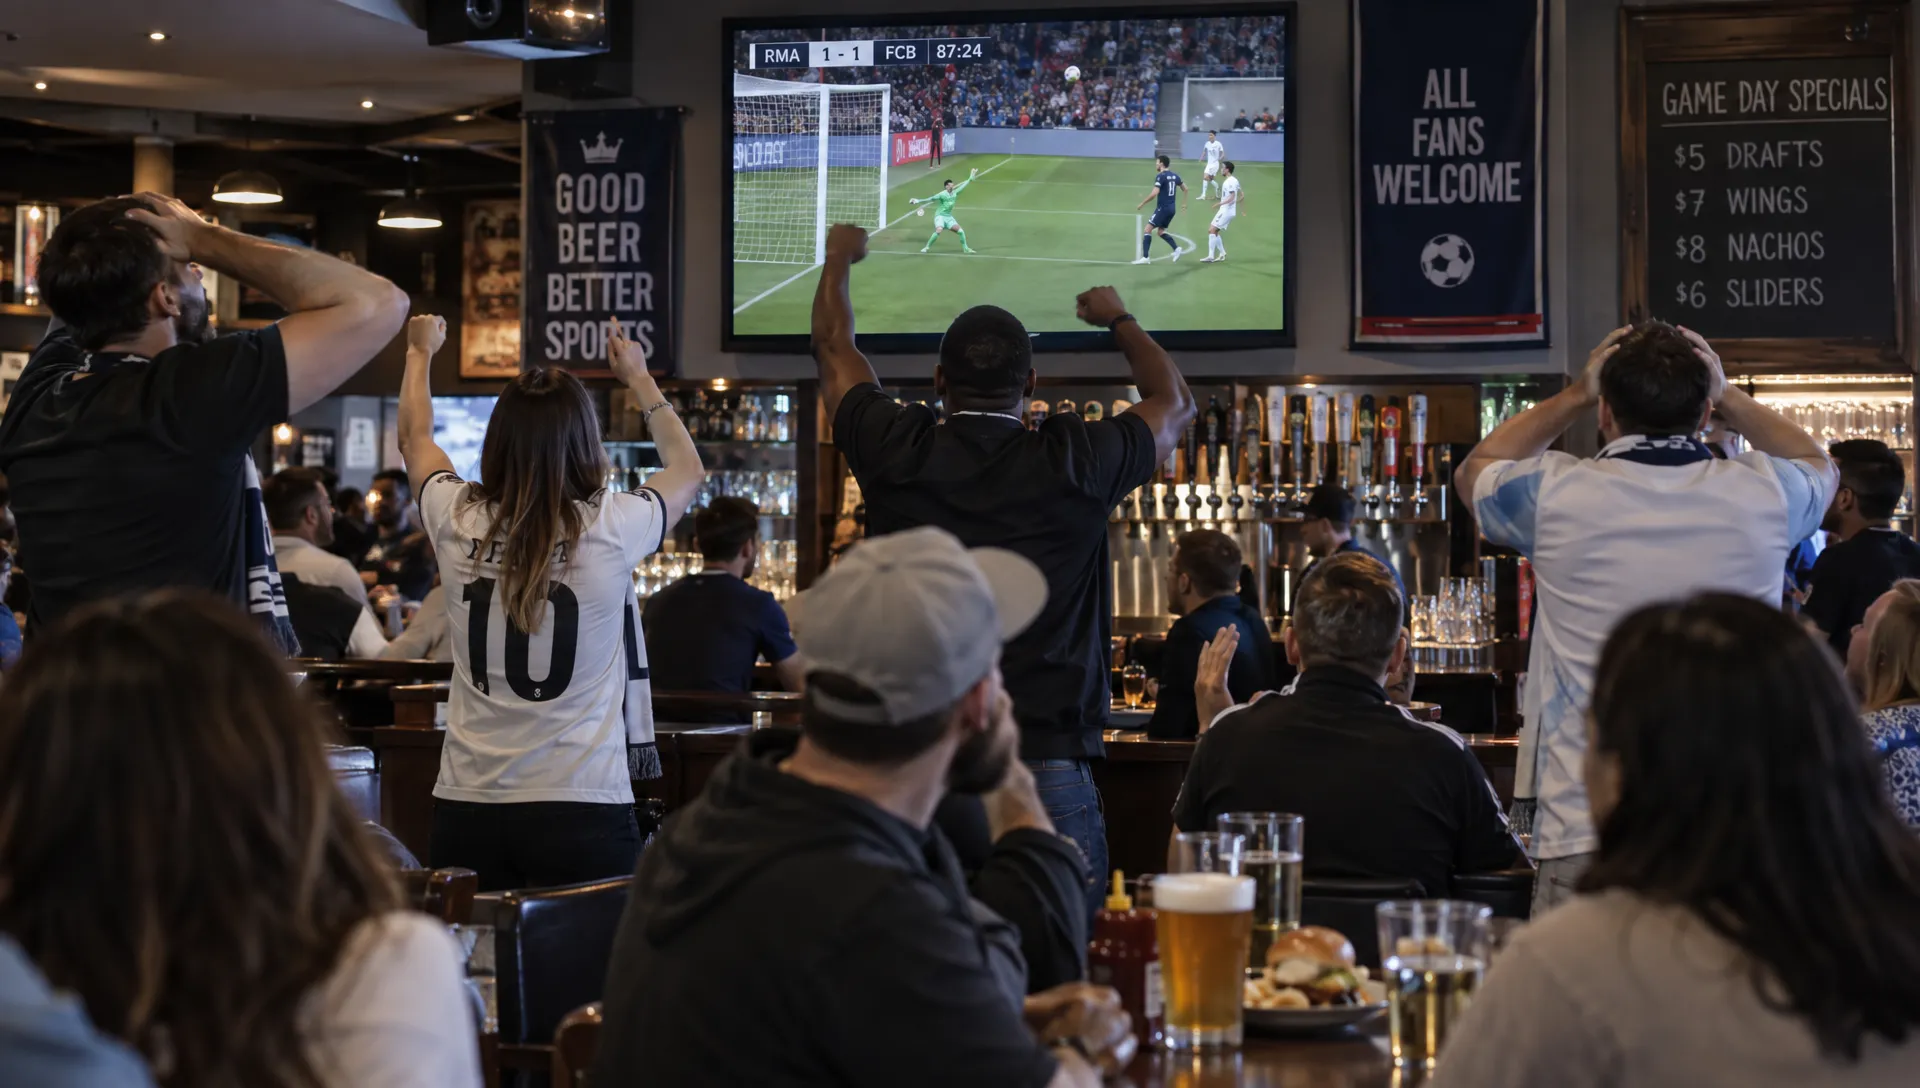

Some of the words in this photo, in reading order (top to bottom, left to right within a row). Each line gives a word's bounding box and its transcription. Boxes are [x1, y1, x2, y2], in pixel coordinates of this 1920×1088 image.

[765, 49, 800, 62] RMA
[823, 48, 829, 61] 1
[853, 47, 859, 60] 1
[886, 46, 916, 59] FCB
[937, 44, 982, 58] 87:24
[1423, 68, 1476, 109] ALL
[1663, 82, 1727, 115] GAME
[1739, 80, 1779, 113] DAY
[1789, 77, 1887, 111] SPECIALS
[1413, 116, 1484, 156] FANS
[1675, 144, 1705, 171] $5
[1728, 140, 1823, 168] DRAFTS
[556, 173, 644, 214] GOOD
[1374, 162, 1521, 204] WELCOME
[1676, 189, 1705, 216] $7
[1727, 186, 1807, 214] WINGS
[558, 222, 640, 263] BEER
[1676, 235, 1705, 262] $8
[1729, 231, 1824, 261] NACHOS
[547, 272, 652, 311] BETTER
[1677, 281, 1706, 308] $6
[1727, 277, 1823, 307] SLIDERS
[462, 577, 579, 701] 10
